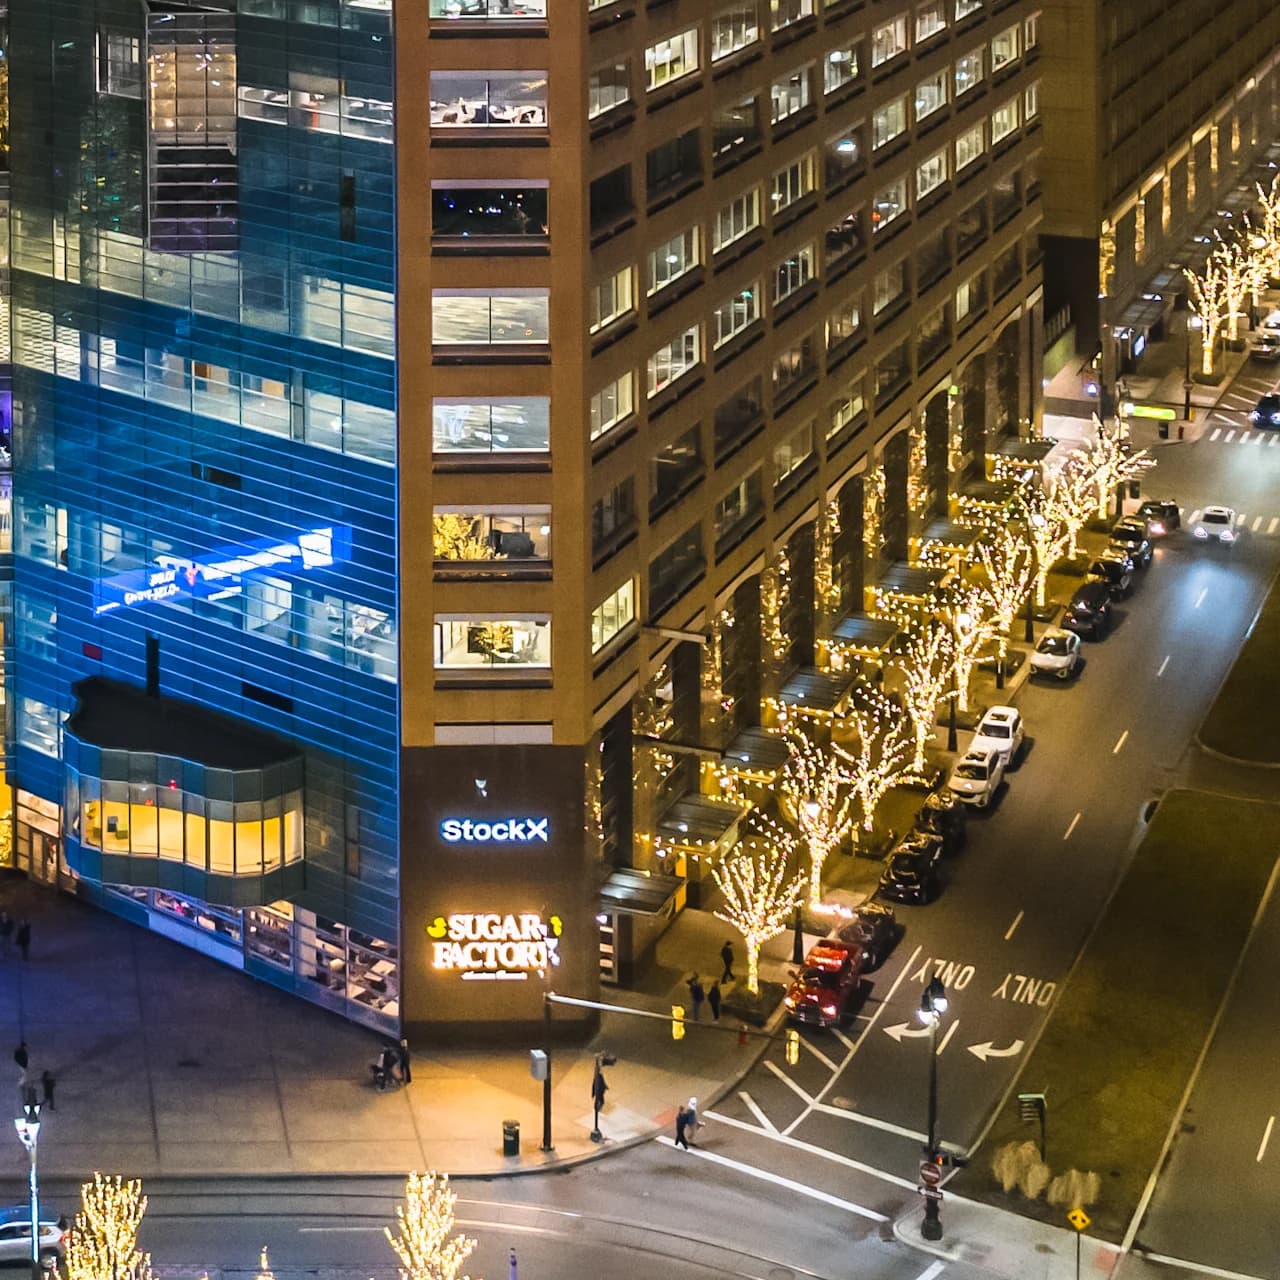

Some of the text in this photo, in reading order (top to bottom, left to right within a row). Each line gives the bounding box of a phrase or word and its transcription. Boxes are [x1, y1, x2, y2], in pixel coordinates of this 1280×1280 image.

[442, 818, 548, 842] StockX
[448, 913, 544, 941] SUGAR
[432, 941, 548, 969] FACTORY
[910, 958, 976, 991] ONLY
[991, 973, 1056, 1007] ONLY
